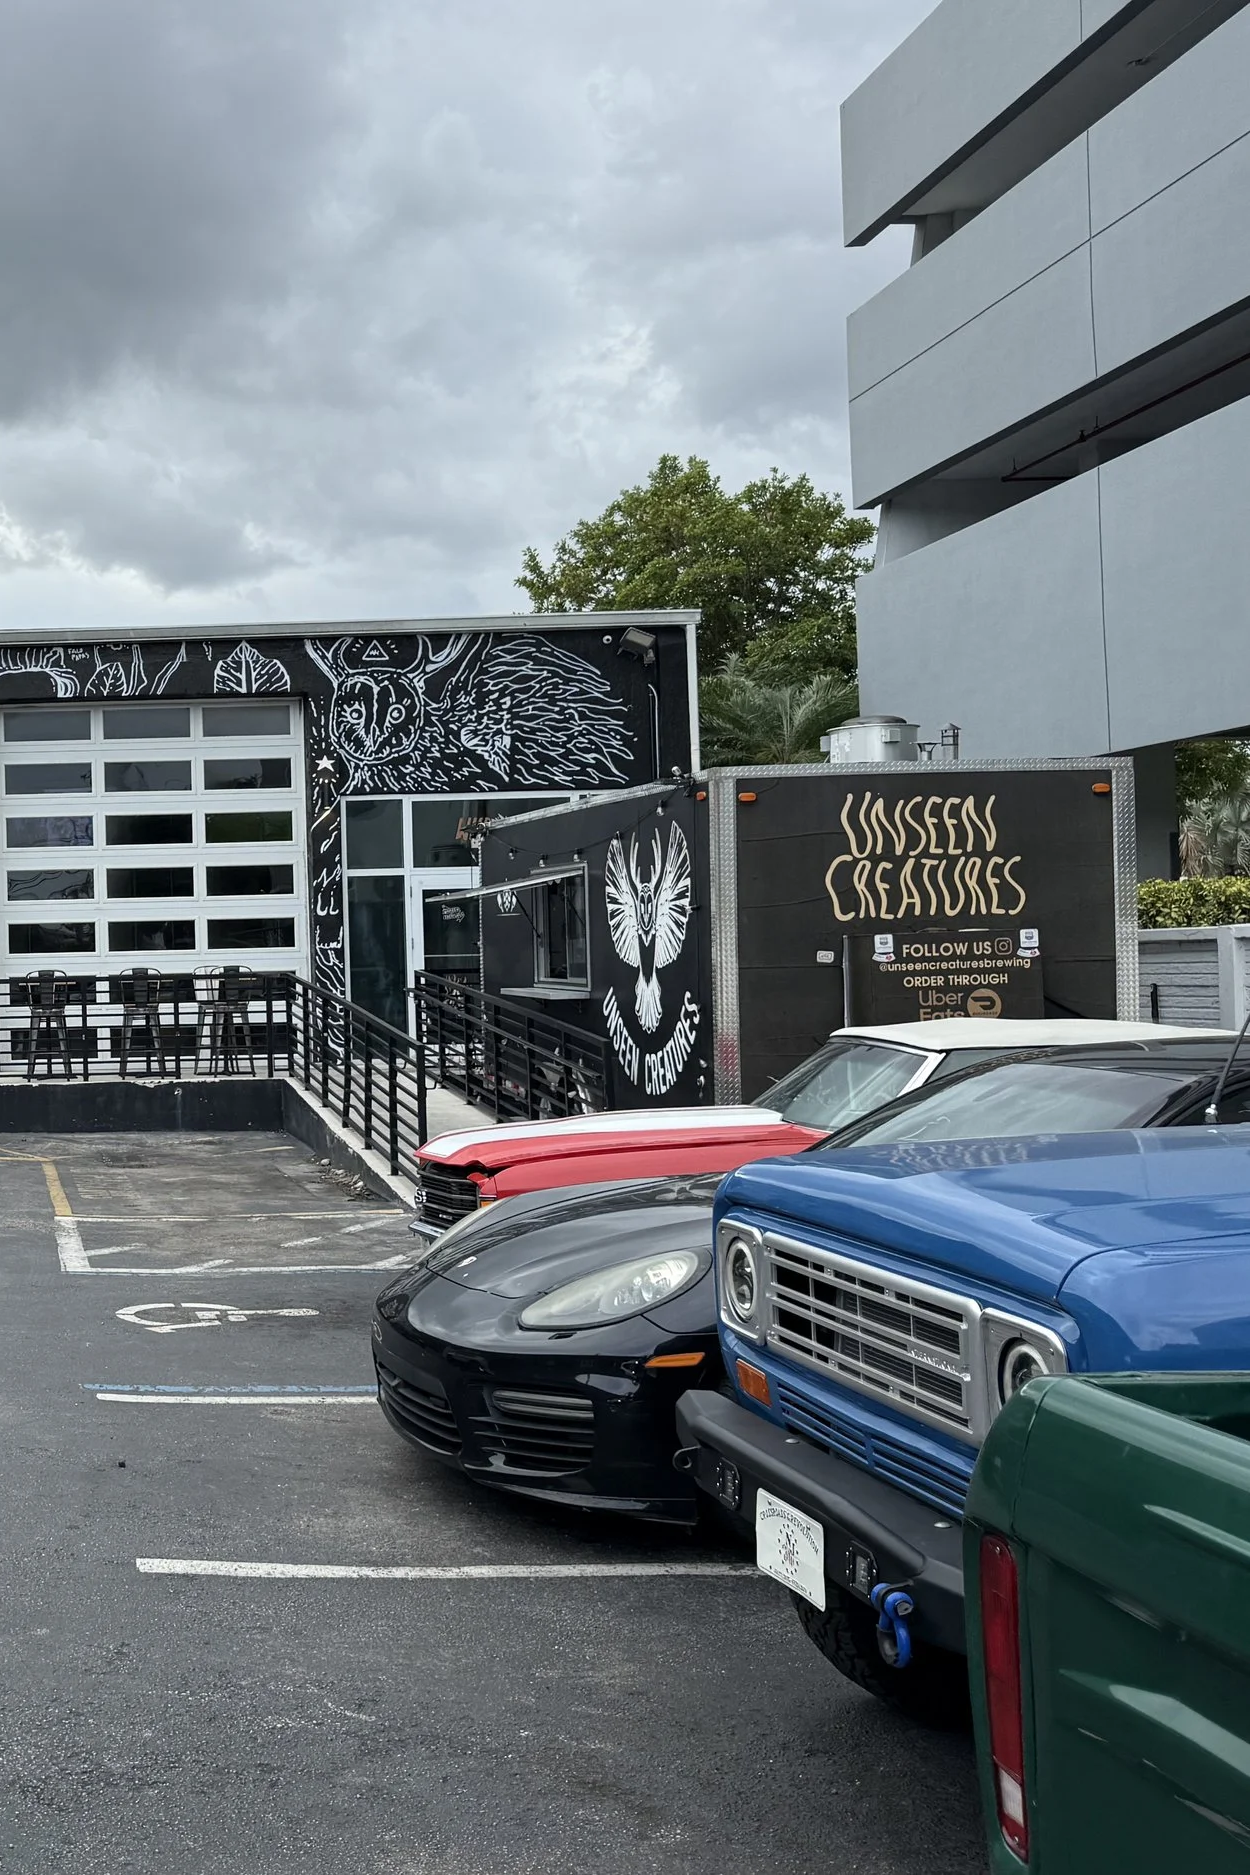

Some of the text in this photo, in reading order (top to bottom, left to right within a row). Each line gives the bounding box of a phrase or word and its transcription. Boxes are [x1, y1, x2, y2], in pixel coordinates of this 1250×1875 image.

[840, 792, 997, 858] UNSEEN
[825, 855, 1027, 921] CREATURES
[902, 941, 992, 957] FOLLOW US
[879, 957, 1031, 972] @unseencreaturesbrewing
[903, 973, 1009, 988] ORDER THROUGH
[918, 990, 964, 1006] Uber
[920, 1008, 966, 1022] Eats
[603, 986, 700, 1095] UNSEEN CREATURES
